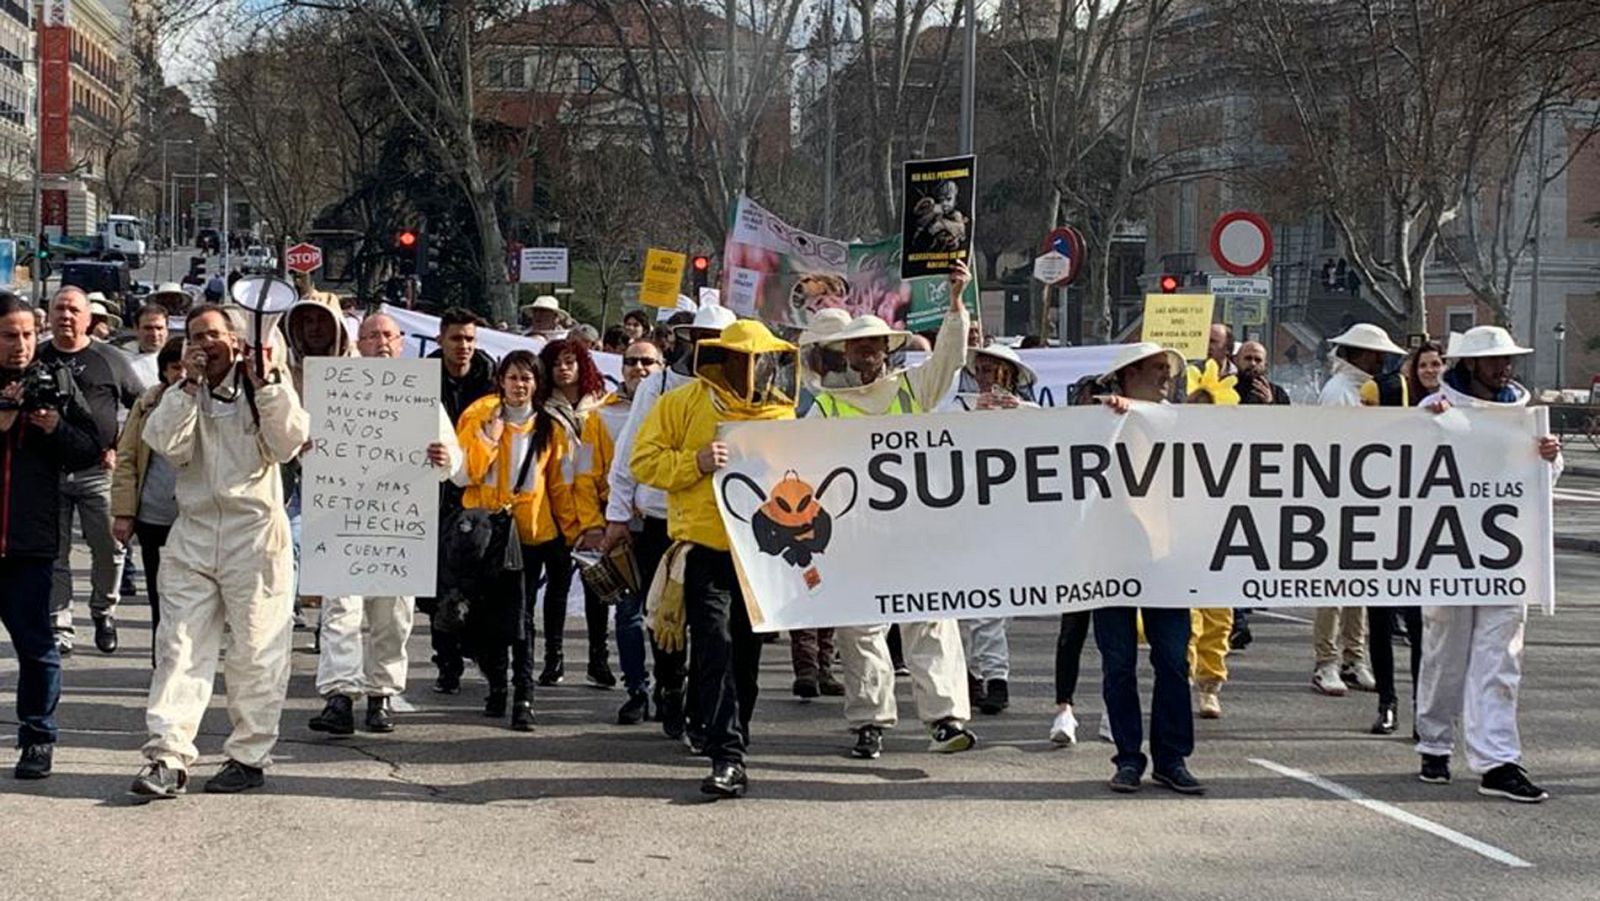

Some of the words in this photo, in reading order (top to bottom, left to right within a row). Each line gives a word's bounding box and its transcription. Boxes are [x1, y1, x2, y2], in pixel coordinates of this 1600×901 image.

[288, 252, 320, 265] STOP
[324, 366, 419, 388] DESDE
[326, 390, 373, 402] HACE
[384, 394, 437, 408] MUCHOS
[327, 405, 399, 422] MUCHOS
[324, 418, 383, 439] AÑOS
[871, 431, 919, 450] POR
[927, 429, 954, 447] LA
[314, 439, 436, 470] RETORICA
[315, 475, 347, 487] MAS
[357, 482, 365, 493] Y
[376, 481, 411, 496] MAS
[867, 442, 1464, 511] SUPERVIVENCIA
[1470, 482, 1490, 498] DE
[1495, 482, 1523, 498] LAS
[313, 493, 420, 518] RETORICA
[344, 515, 426, 536] HECHOS
[1209, 504, 1523, 572] ABEJAS
[315, 541, 327, 554] A
[344, 543, 407, 559] CUENTA
[350, 561, 408, 578] GOTAS
[875, 588, 1001, 614] TENEMOS
[1009, 585, 1047, 607] UN
[1056, 578, 1142, 604] PASADO
[1242, 579, 1379, 601] QUEREMOS
[1387, 579, 1422, 598] UN
[1430, 577, 1527, 597] FUTURO
